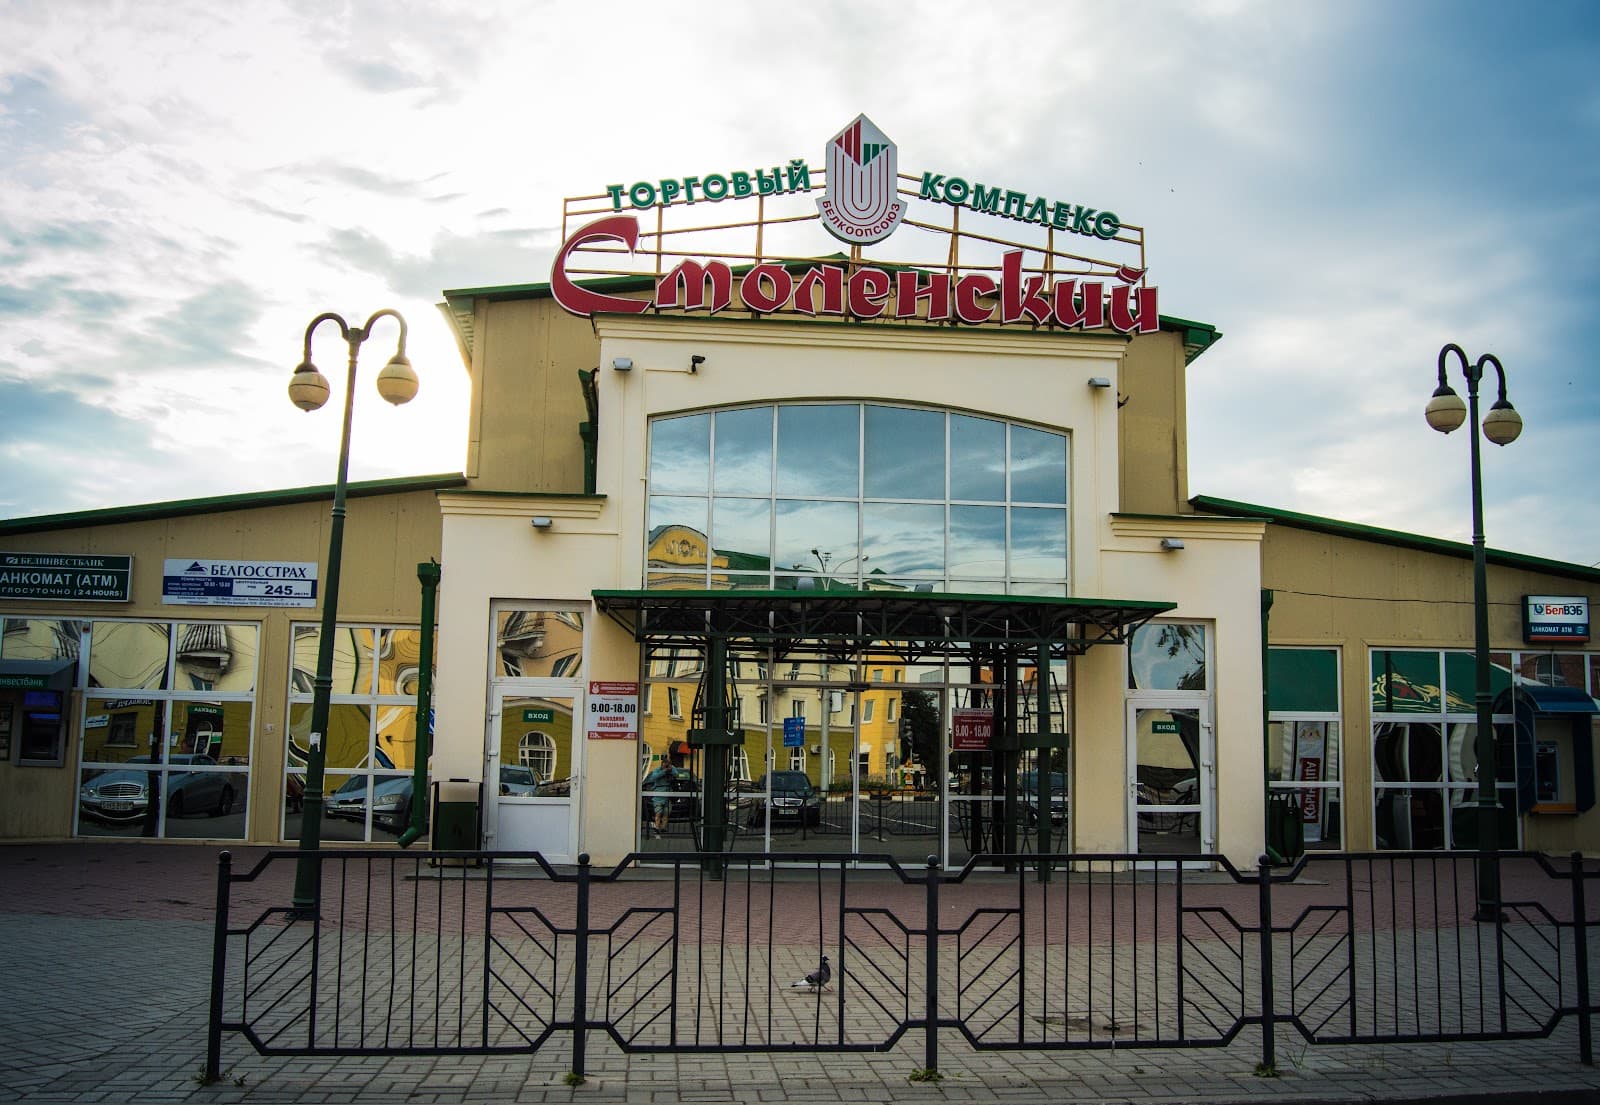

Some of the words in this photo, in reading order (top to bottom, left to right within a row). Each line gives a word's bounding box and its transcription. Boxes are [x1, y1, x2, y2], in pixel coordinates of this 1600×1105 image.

[606, 159, 811, 212] ТОРГОВЫЙ
[918, 171, 1121, 239] КОМПЛЕКС
[822, 200, 900, 237] БЕЛКООПСОЮЗ
[550, 214, 1159, 334] Смоленский
[211, 564, 306, 578] БЕЛГОССТРАХ
[265, 585, 293, 595] 245
[1545, 604, 1583, 616] БелВЭБ
[1531, 625, 1559, 633] БАНКОМАТ
